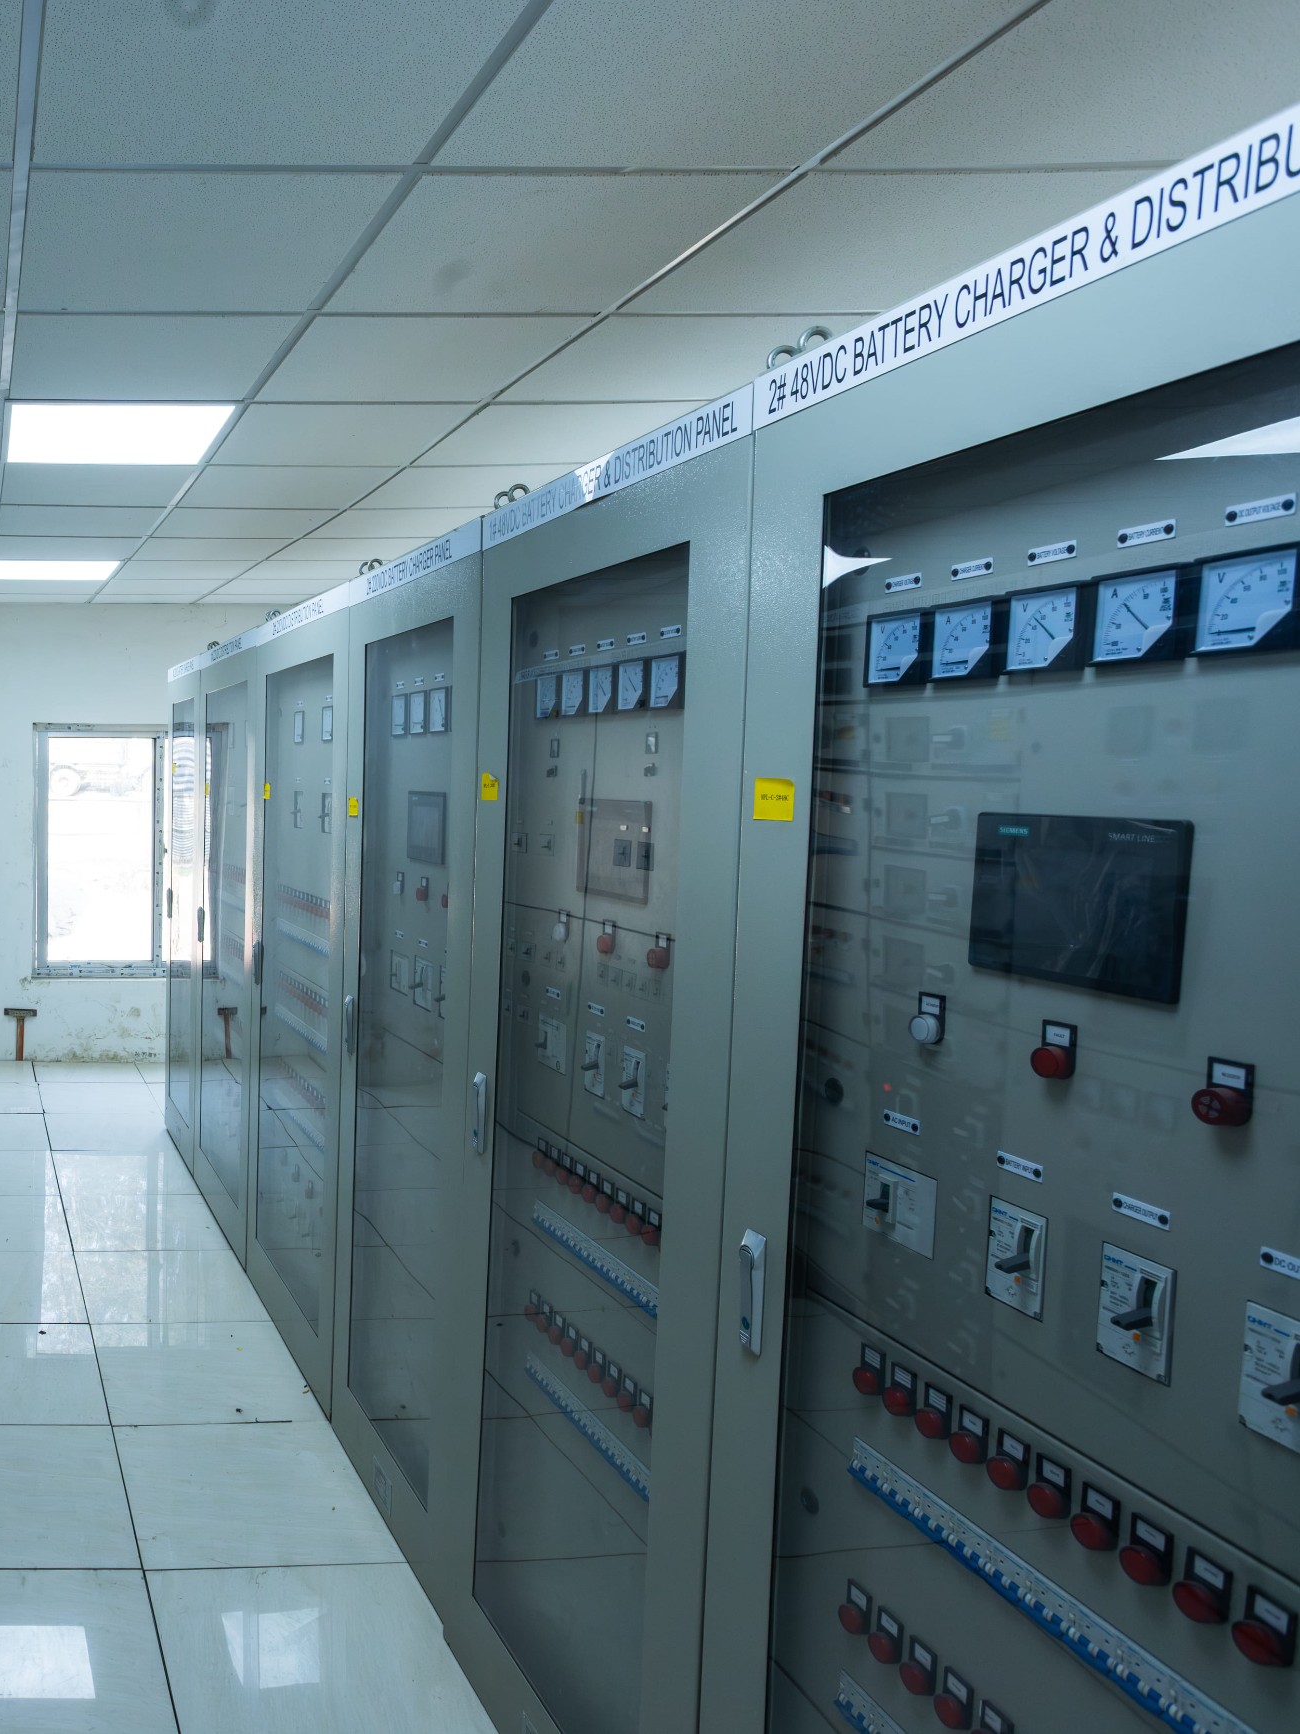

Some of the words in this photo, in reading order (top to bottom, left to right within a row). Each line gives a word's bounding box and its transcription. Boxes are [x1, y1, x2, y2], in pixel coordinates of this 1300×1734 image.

[768, 365, 787, 415] 2#
[791, 345, 847, 404] 48VDC
[853, 293, 949, 377] BATTERY
[954, 225, 1089, 328] CHARGER
[1100, 211, 1119, 263] &
[489, 520, 497, 542] 1#
[497, 508, 521, 538] 48VDC
[522, 491, 556, 526] BATTERY
[558, 464, 602, 510] CHARGER
[603, 464, 611, 488] &
[614, 420, 692, 484] DISTRIBUTION
[695, 401, 738, 449] PANEL
[388, 561, 408, 587] BATTERY
[409, 547, 435, 577] CHARGER
[434, 539, 453, 565] PANEL
[1217, 571, 1226, 584] V
[1111, 587, 1118, 599] A
[1022, 602, 1028, 613] V
[999, 825, 1029, 836] SIEMENS
[1108, 832, 1136, 842] SMART
[1137, 834, 1155, 843] LINE
[891, 1116, 898, 1124] AC
[897, 1119, 911, 1128] INPUT
[1006, 1157, 1022, 1171] BATTERY
[1274, 1256, 1286, 1268] DC
